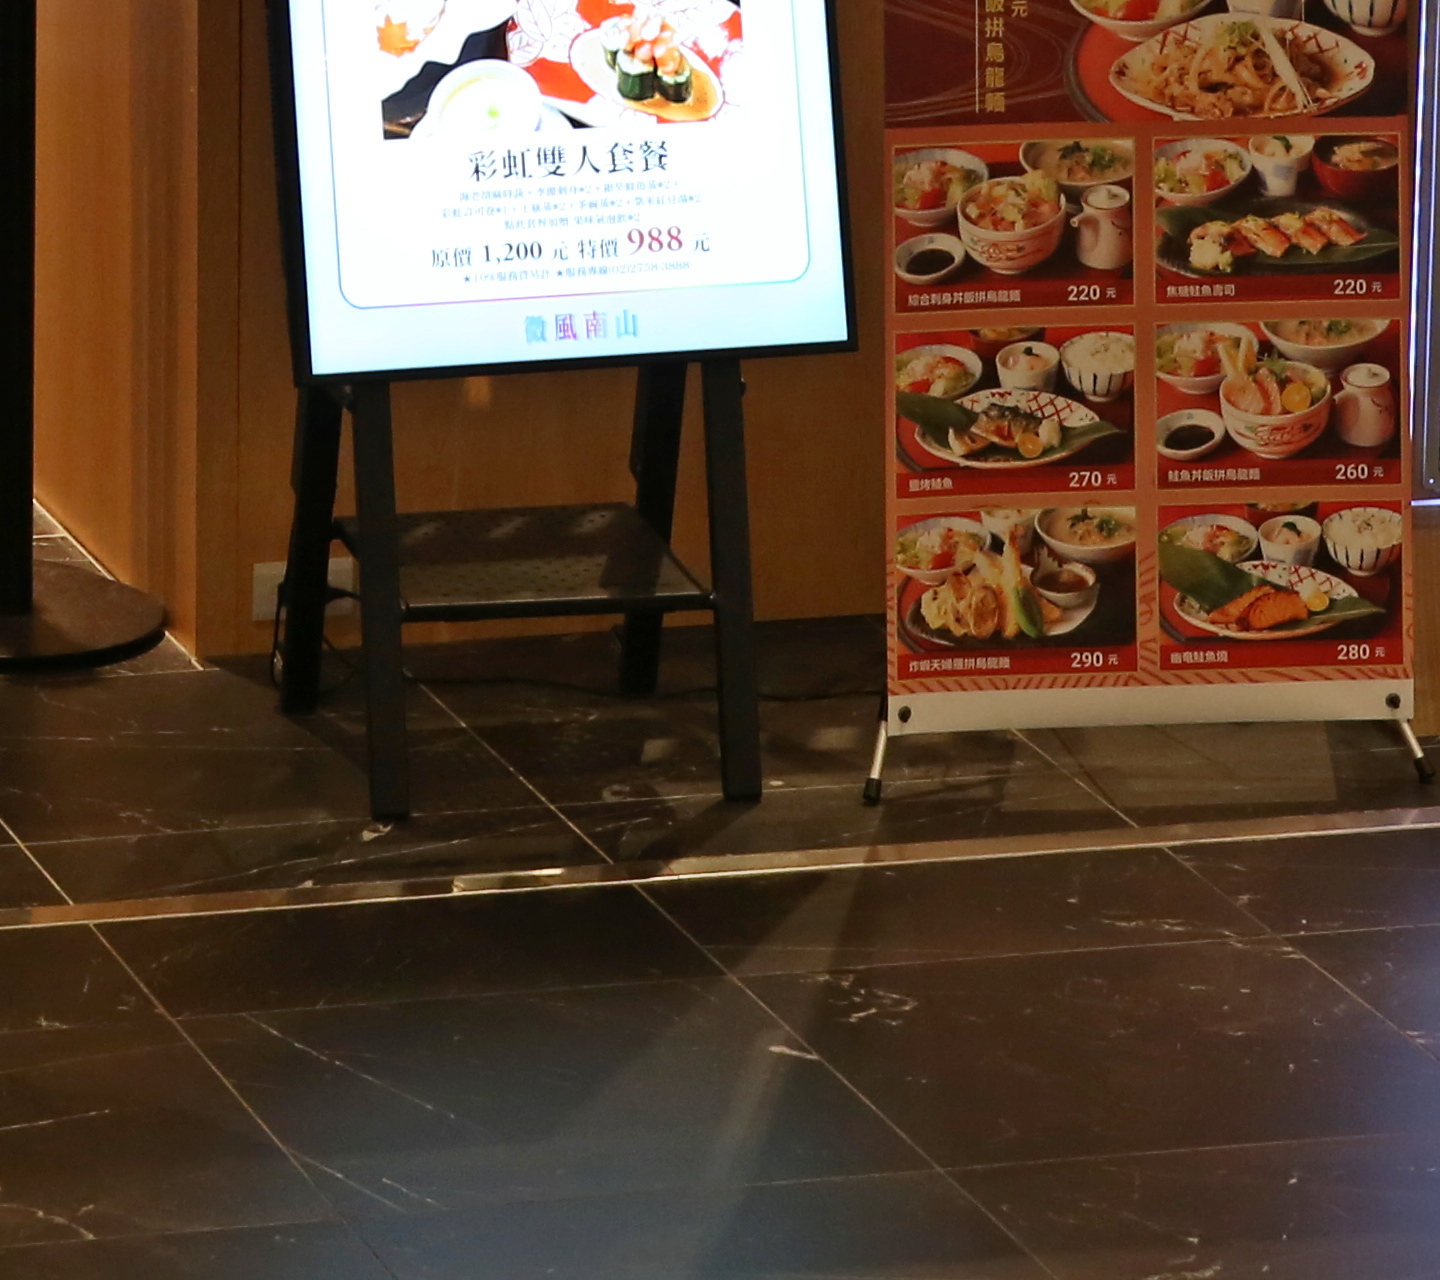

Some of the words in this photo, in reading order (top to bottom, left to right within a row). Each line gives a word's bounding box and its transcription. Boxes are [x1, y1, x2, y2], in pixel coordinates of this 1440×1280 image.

[468, 140, 669, 183] 彩虹雙人套餐
[483, 240, 543, 265] 1,200
[627, 225, 683, 255] 988
[1067, 285, 1100, 301] 220
[1105, 288, 1117, 299] 元
[1333, 279, 1367, 295] 220
[1371, 282, 1382, 293] 元
[524, 309, 639, 344] 微風南山
[1069, 471, 1102, 487] 270
[1106, 474, 1118, 485] 元
[1335, 463, 1369, 480] 260
[1373, 466, 1384, 477] 元
[1070, 651, 1103, 668] 290
[1108, 654, 1119, 665] 元
[1337, 644, 1370, 660] 280
[1375, 646, 1386, 657] 元
